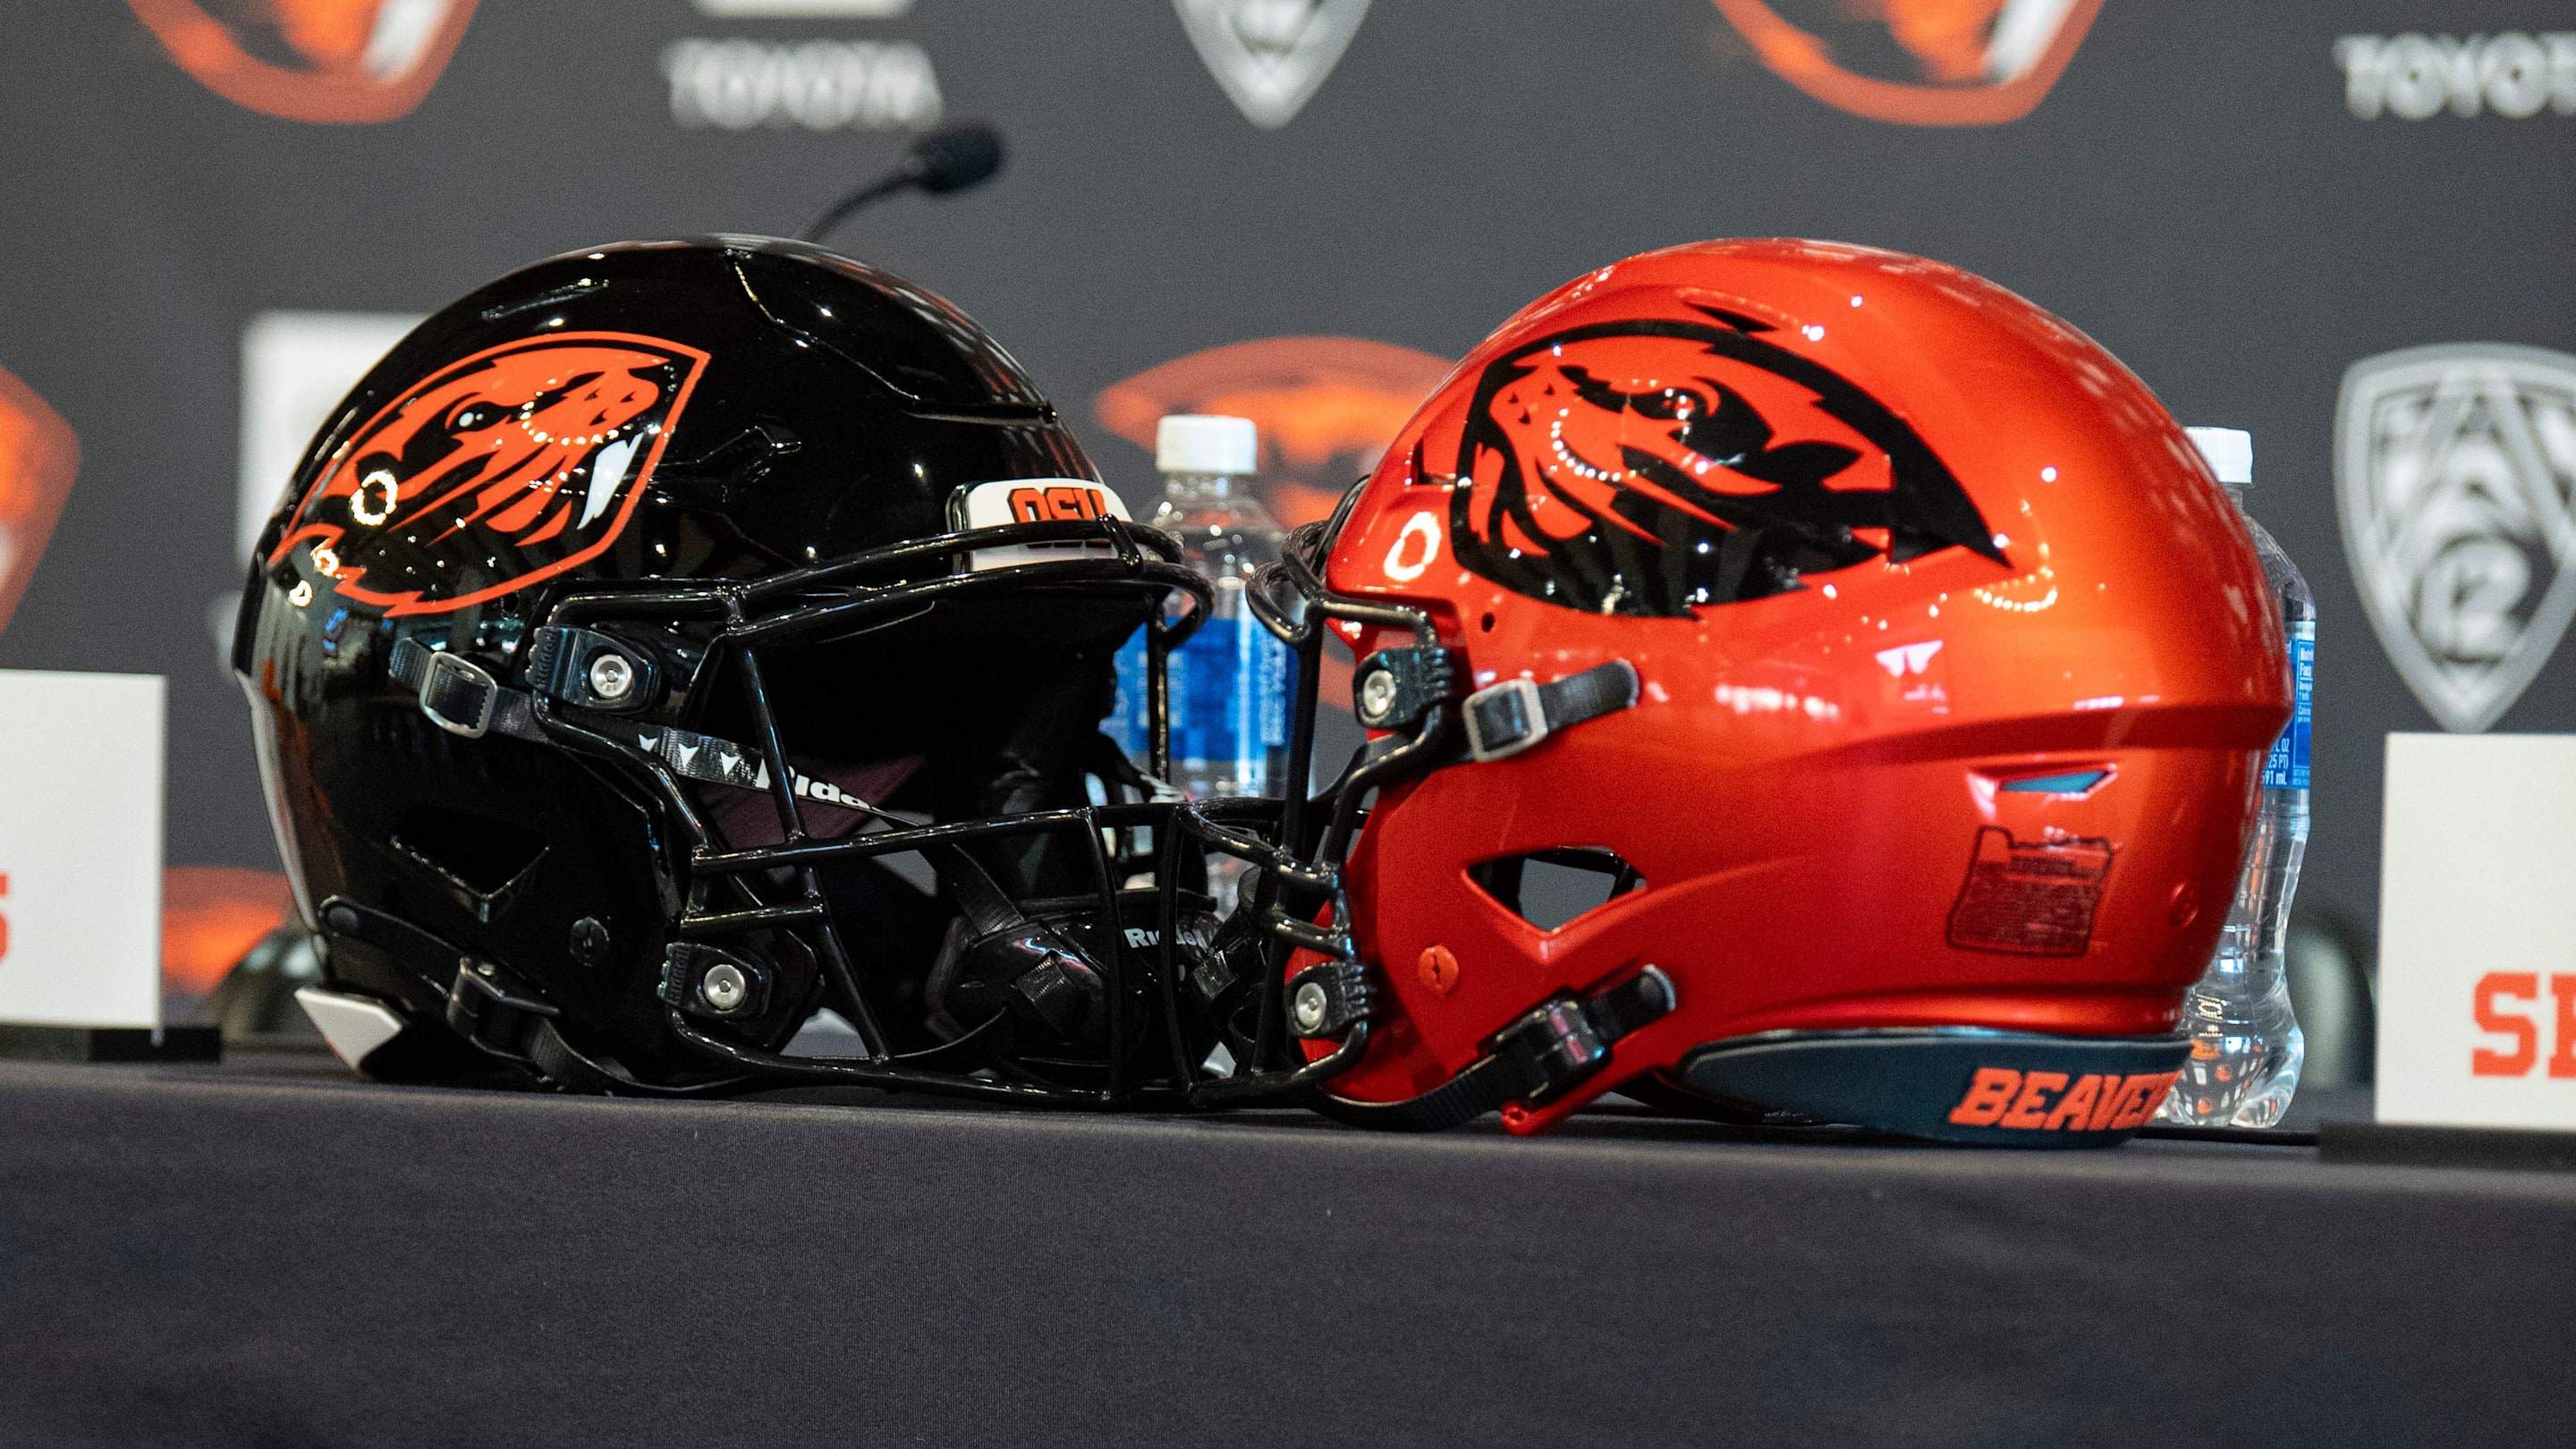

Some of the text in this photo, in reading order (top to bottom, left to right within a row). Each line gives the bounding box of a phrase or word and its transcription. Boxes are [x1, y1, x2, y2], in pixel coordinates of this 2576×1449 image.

[2333, 33, 2576, 119] TOYOT
[1123, 924, 1209, 953] Ridell
[1949, 1067, 2183, 1131] BEAVE
